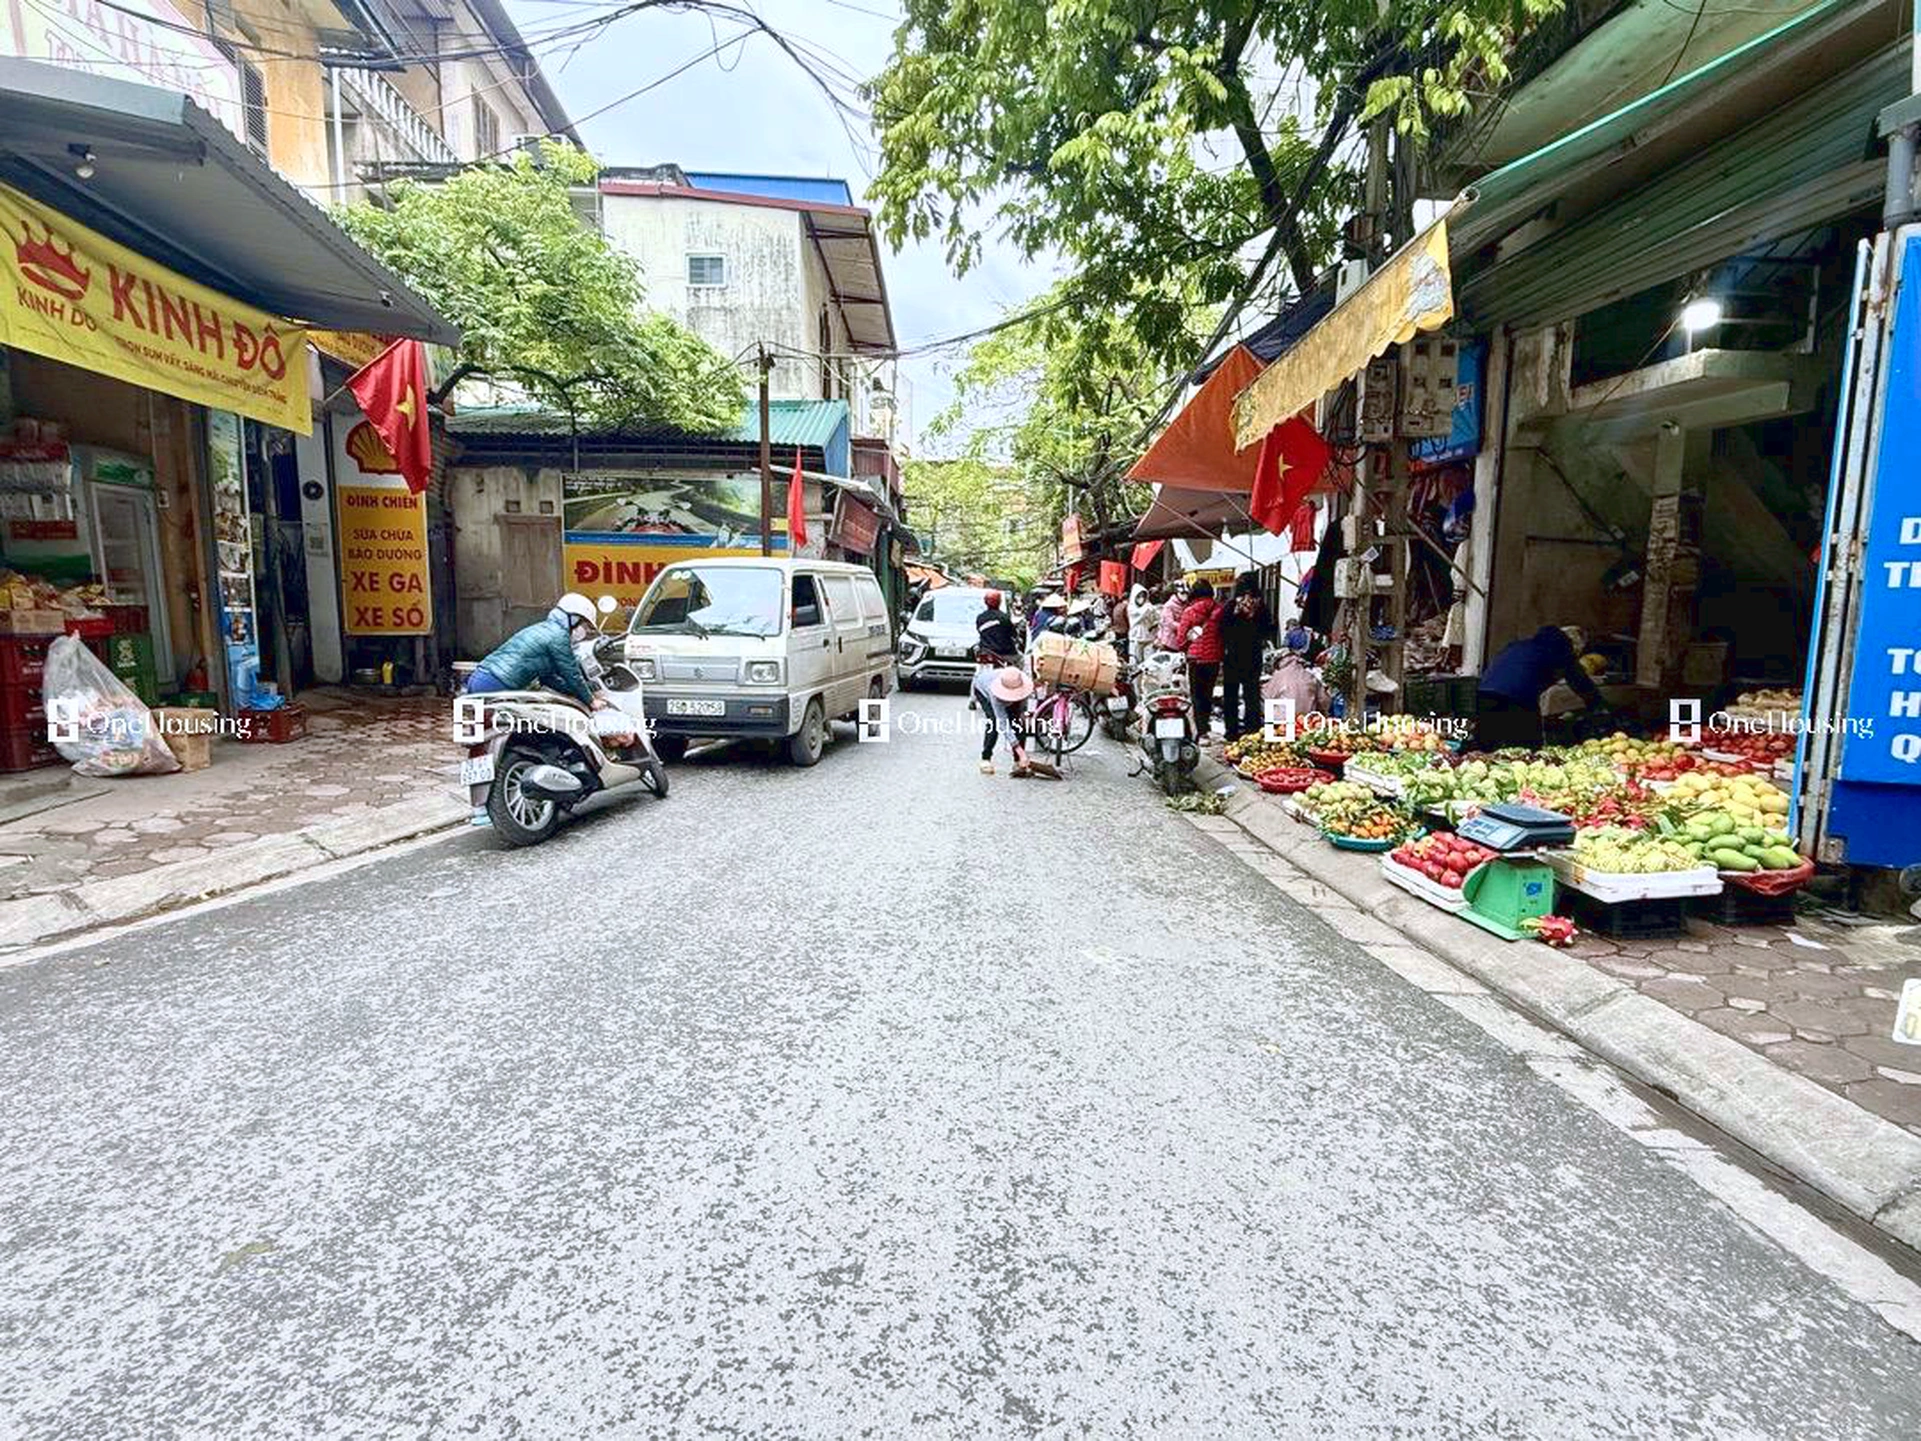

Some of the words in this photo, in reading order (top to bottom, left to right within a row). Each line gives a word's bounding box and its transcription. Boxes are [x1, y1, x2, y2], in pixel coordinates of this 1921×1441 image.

[16, 285, 65, 321] KINH
[107, 262, 224, 361] KINH
[232, 320, 287, 382] ĐÔ
[350, 570, 381, 593] XE
[388, 570, 424, 594] GA
[354, 605, 385, 628] XE
[391, 599, 425, 628] SỐ
